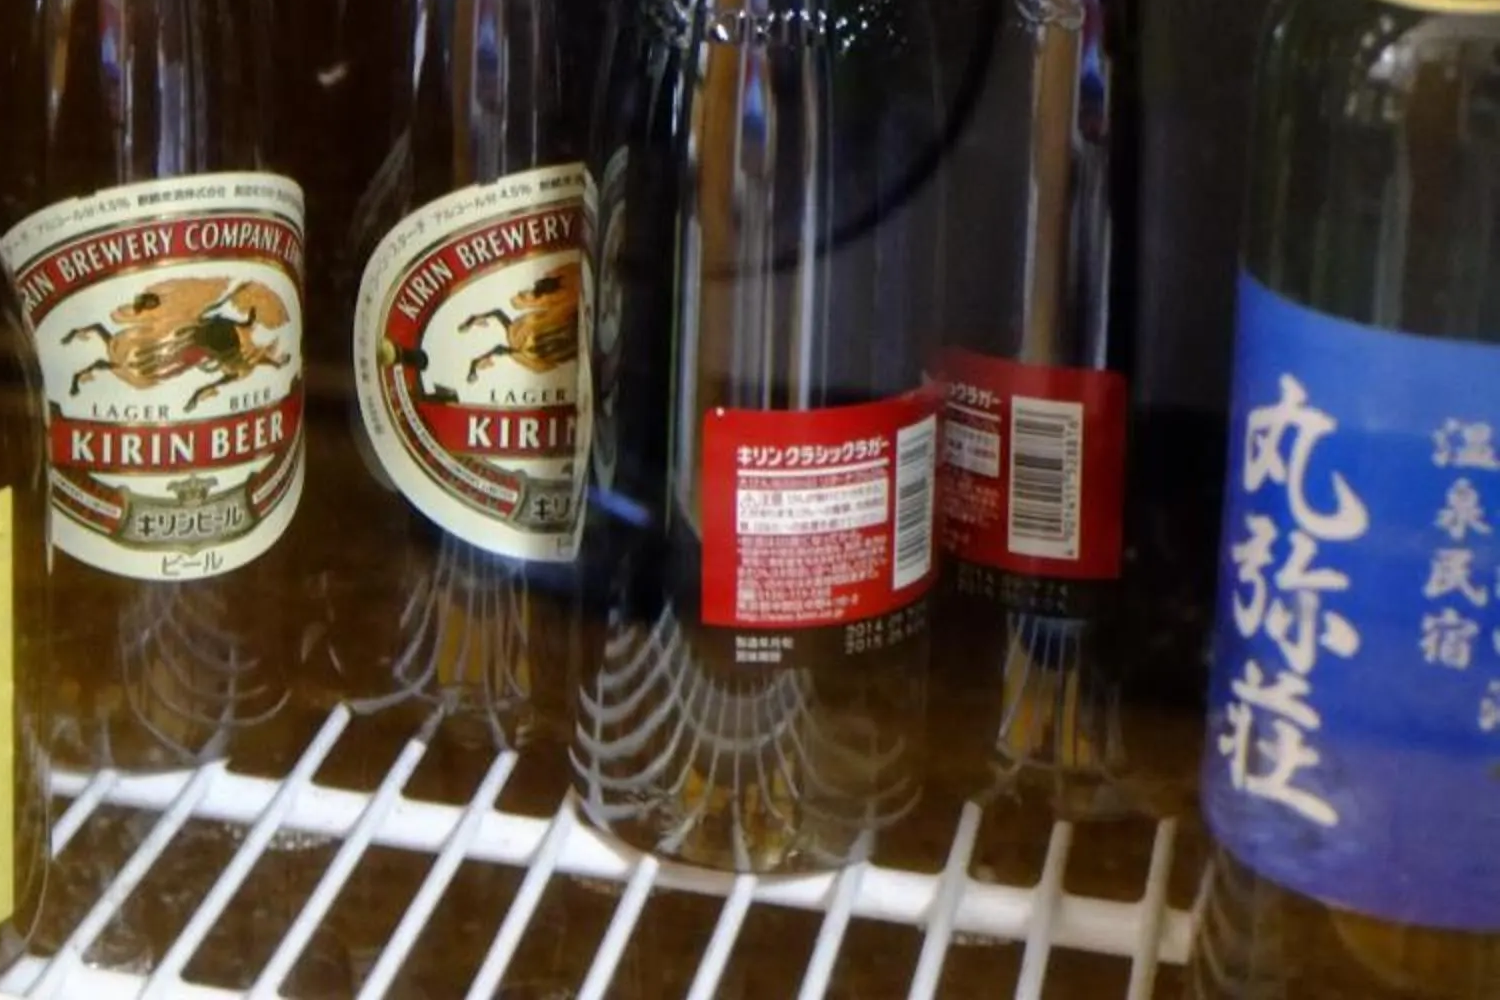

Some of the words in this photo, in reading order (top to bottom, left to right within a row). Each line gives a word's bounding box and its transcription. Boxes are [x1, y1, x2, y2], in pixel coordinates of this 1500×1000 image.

[56, 227, 176, 281] BREWERY
[396, 257, 454, 321] KIRIN
[455, 212, 576, 271] BREWERY
[92, 402, 170, 420] LAGER
[230, 388, 272, 411] BEER
[70, 429, 195, 465] KIRIN
[211, 411, 285, 460] BEER
[138, 505, 243, 537] キリンビール
[161, 552, 224, 576] ビール
[1217, 373, 1369, 828] 丸弥荘
